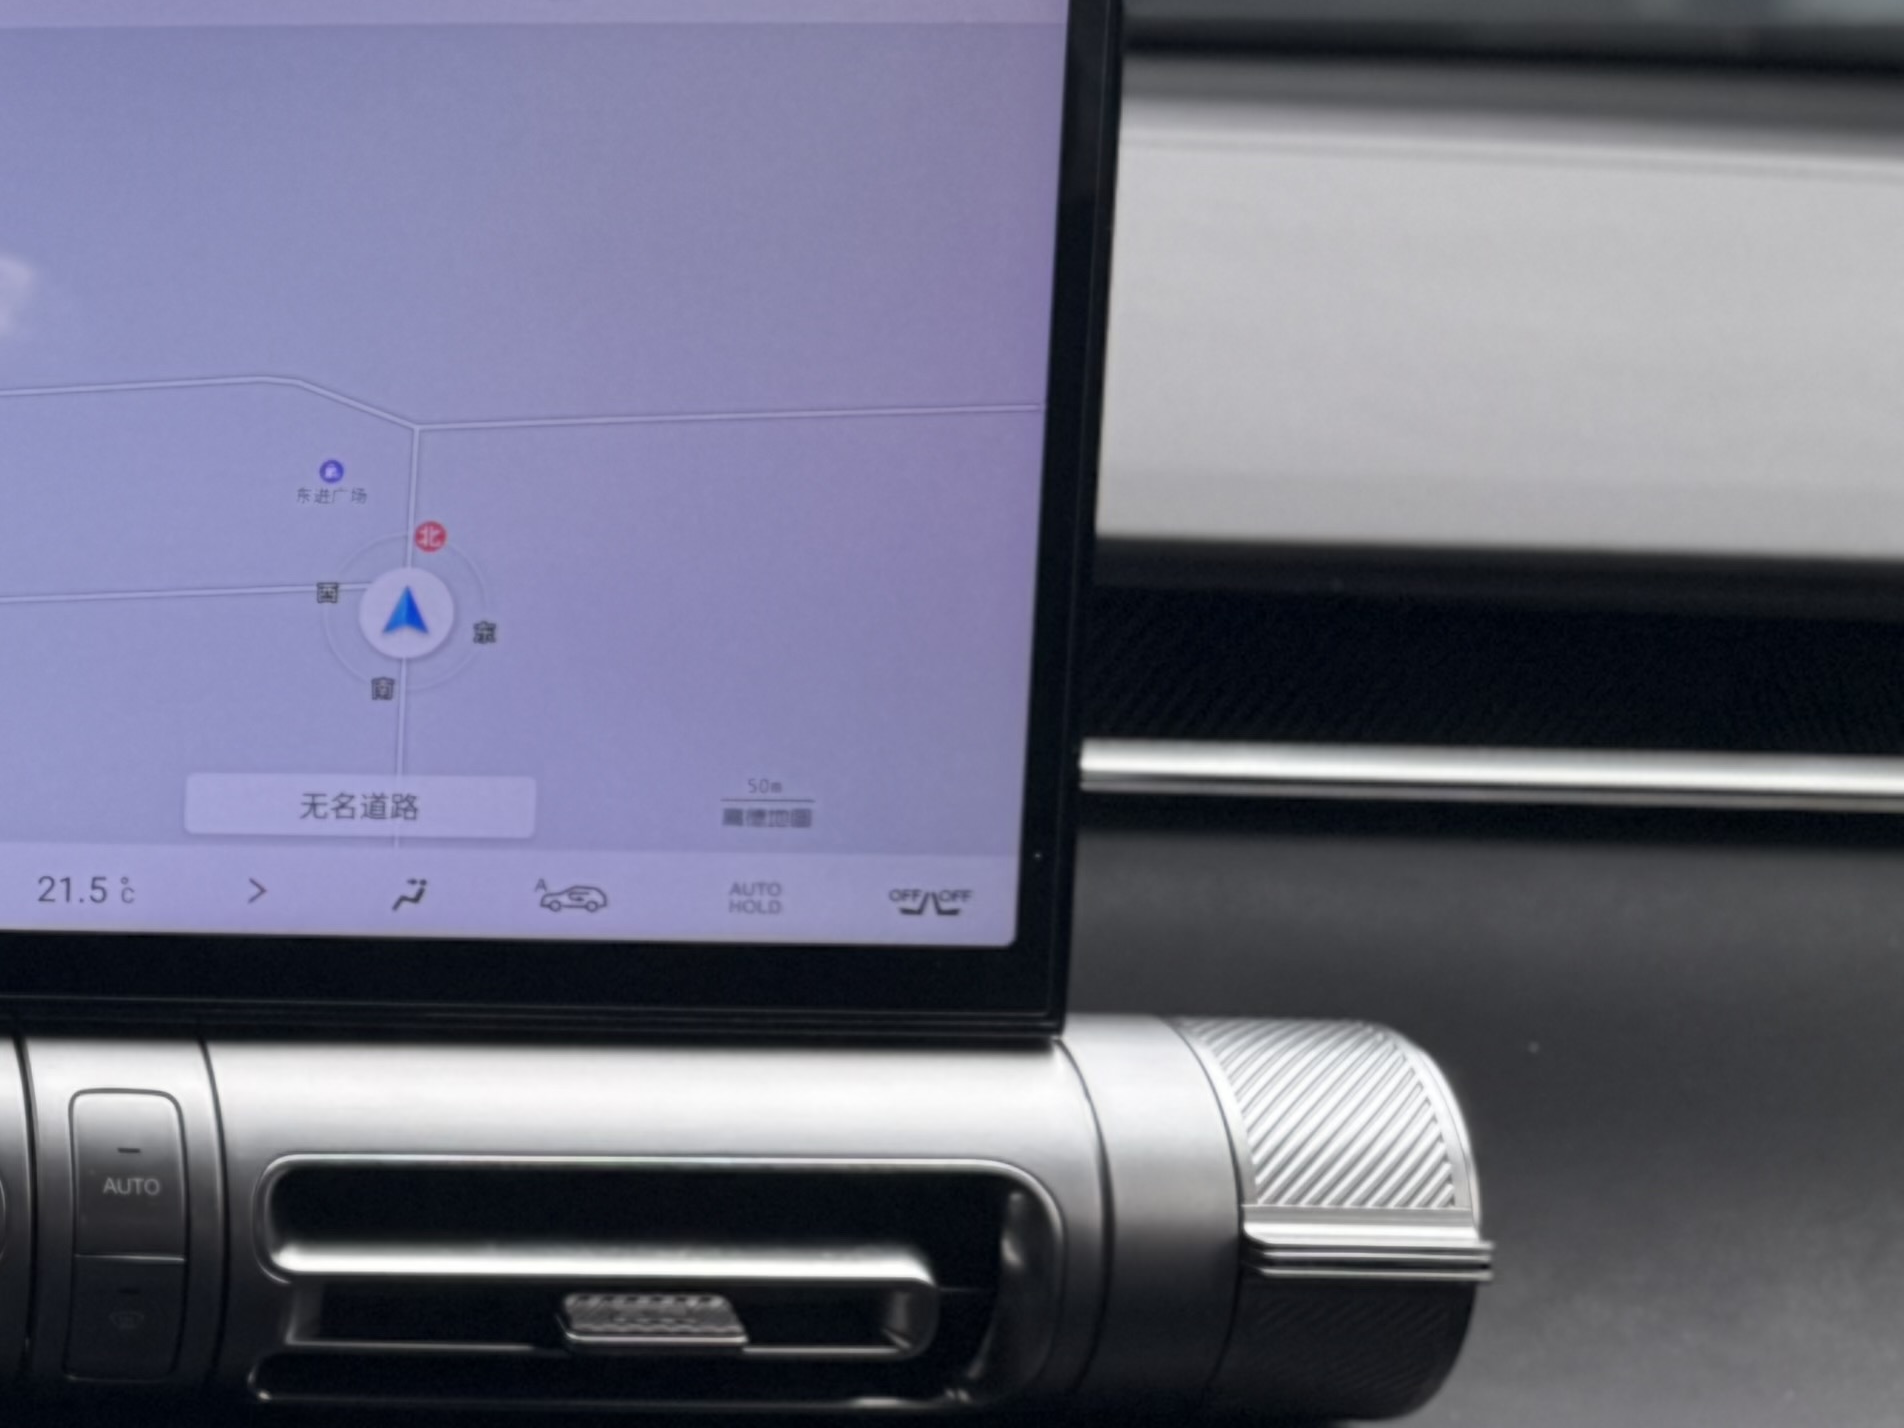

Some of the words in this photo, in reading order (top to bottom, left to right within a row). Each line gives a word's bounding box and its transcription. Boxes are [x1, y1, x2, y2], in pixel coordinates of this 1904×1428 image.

[417, 526, 443, 549] 北
[299, 792, 420, 821] 无名道路
[37, 875, 108, 904] 21.5
[729, 881, 781, 897] AUTO
[889, 889, 922, 903] OFF
[938, 889, 972, 903] OFF
[729, 898, 782, 915] HOLD
[102, 1177, 162, 1197] AUTO
